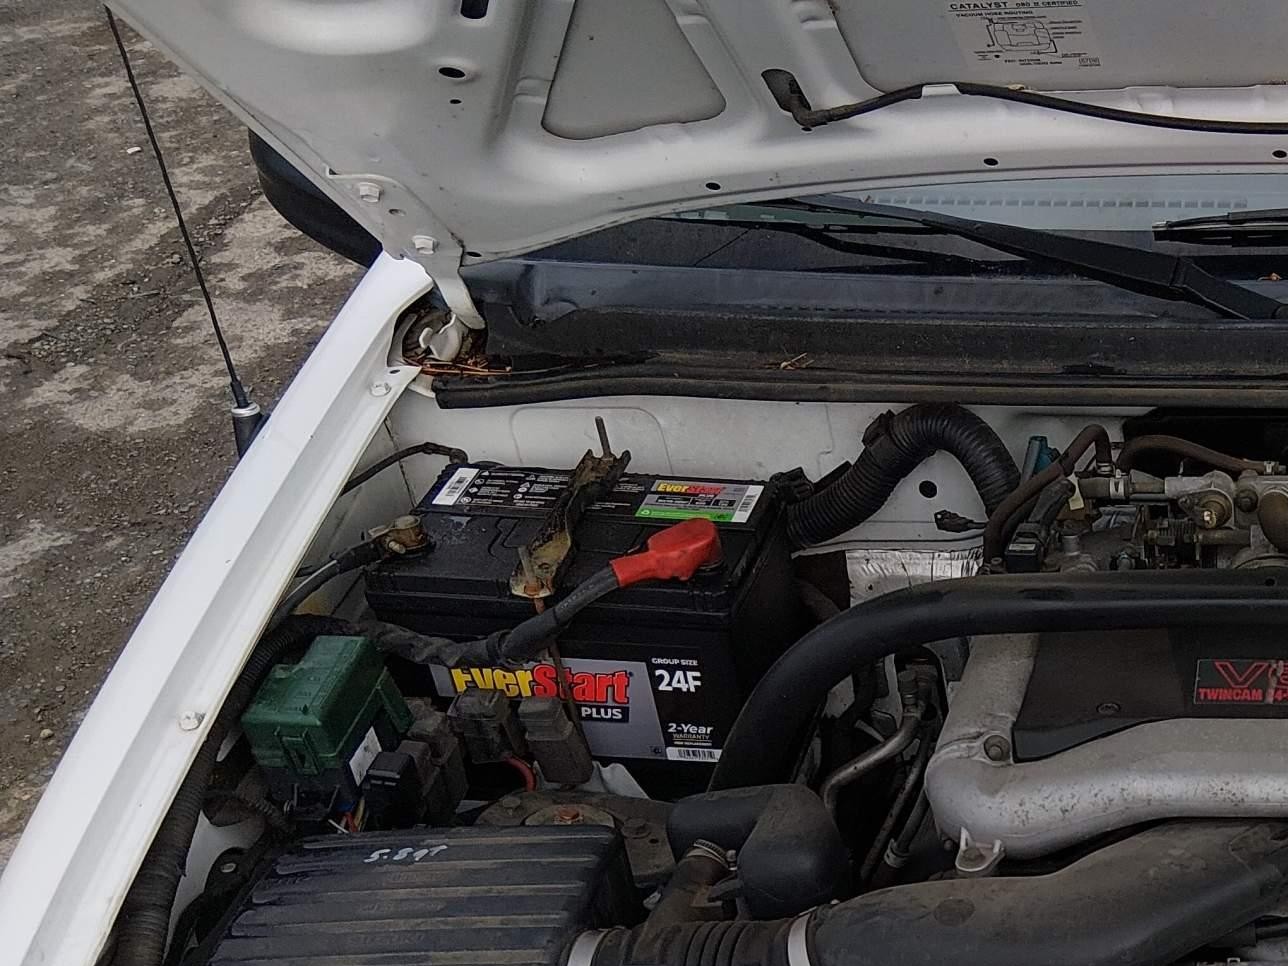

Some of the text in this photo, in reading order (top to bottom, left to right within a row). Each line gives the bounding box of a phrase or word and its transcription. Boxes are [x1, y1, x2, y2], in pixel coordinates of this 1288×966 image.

[450, 664, 629, 704] EverStart
[654, 669, 702, 692] 24F
[1199, 688, 1263, 700] TWINCAM
[581, 707, 622, 719] PLUS
[667, 723, 714, 734] 2-Year
